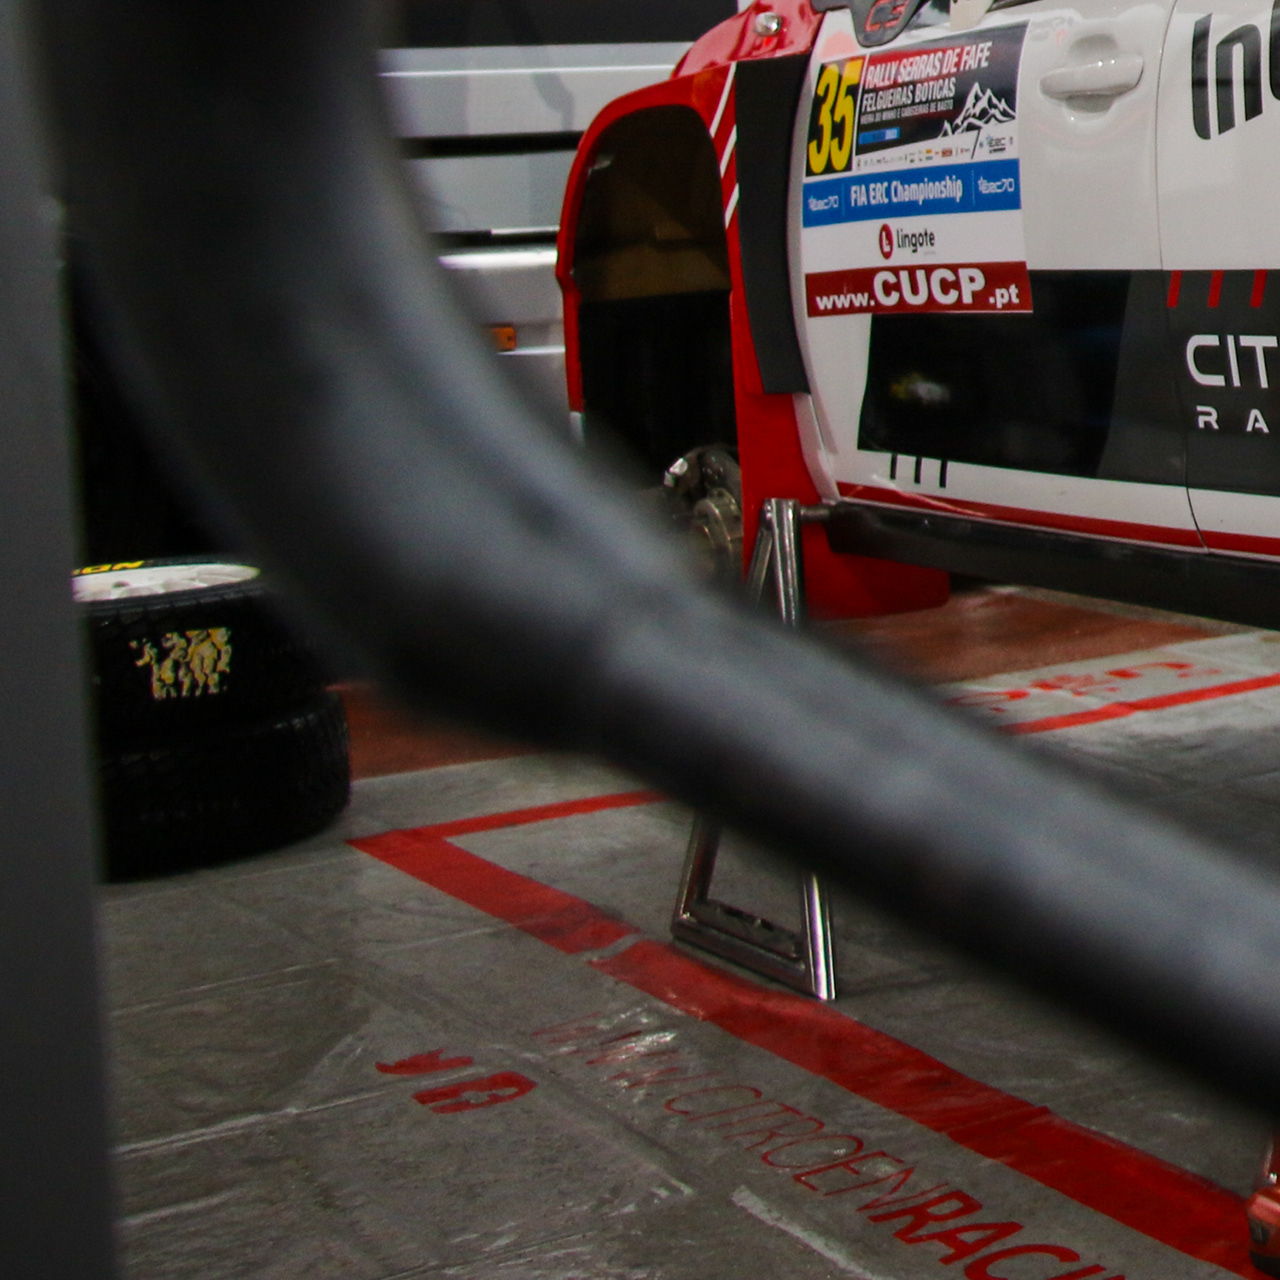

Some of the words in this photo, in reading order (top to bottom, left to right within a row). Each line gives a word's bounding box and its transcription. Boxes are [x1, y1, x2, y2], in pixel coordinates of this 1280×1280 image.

[865, 60, 899, 90] RALLY
[897, 53, 942, 84] SERRAS
[942, 48, 959, 74] DE
[959, 41, 994, 70] FAFE
[808, 58, 863, 174] 35
[861, 83, 914, 113] FELGUEIRAS
[914, 77, 957, 104] BOTICAS
[851, 183, 868, 208] FIA
[869, 181, 889, 206] ERC
[891, 174, 964, 206] Championship
